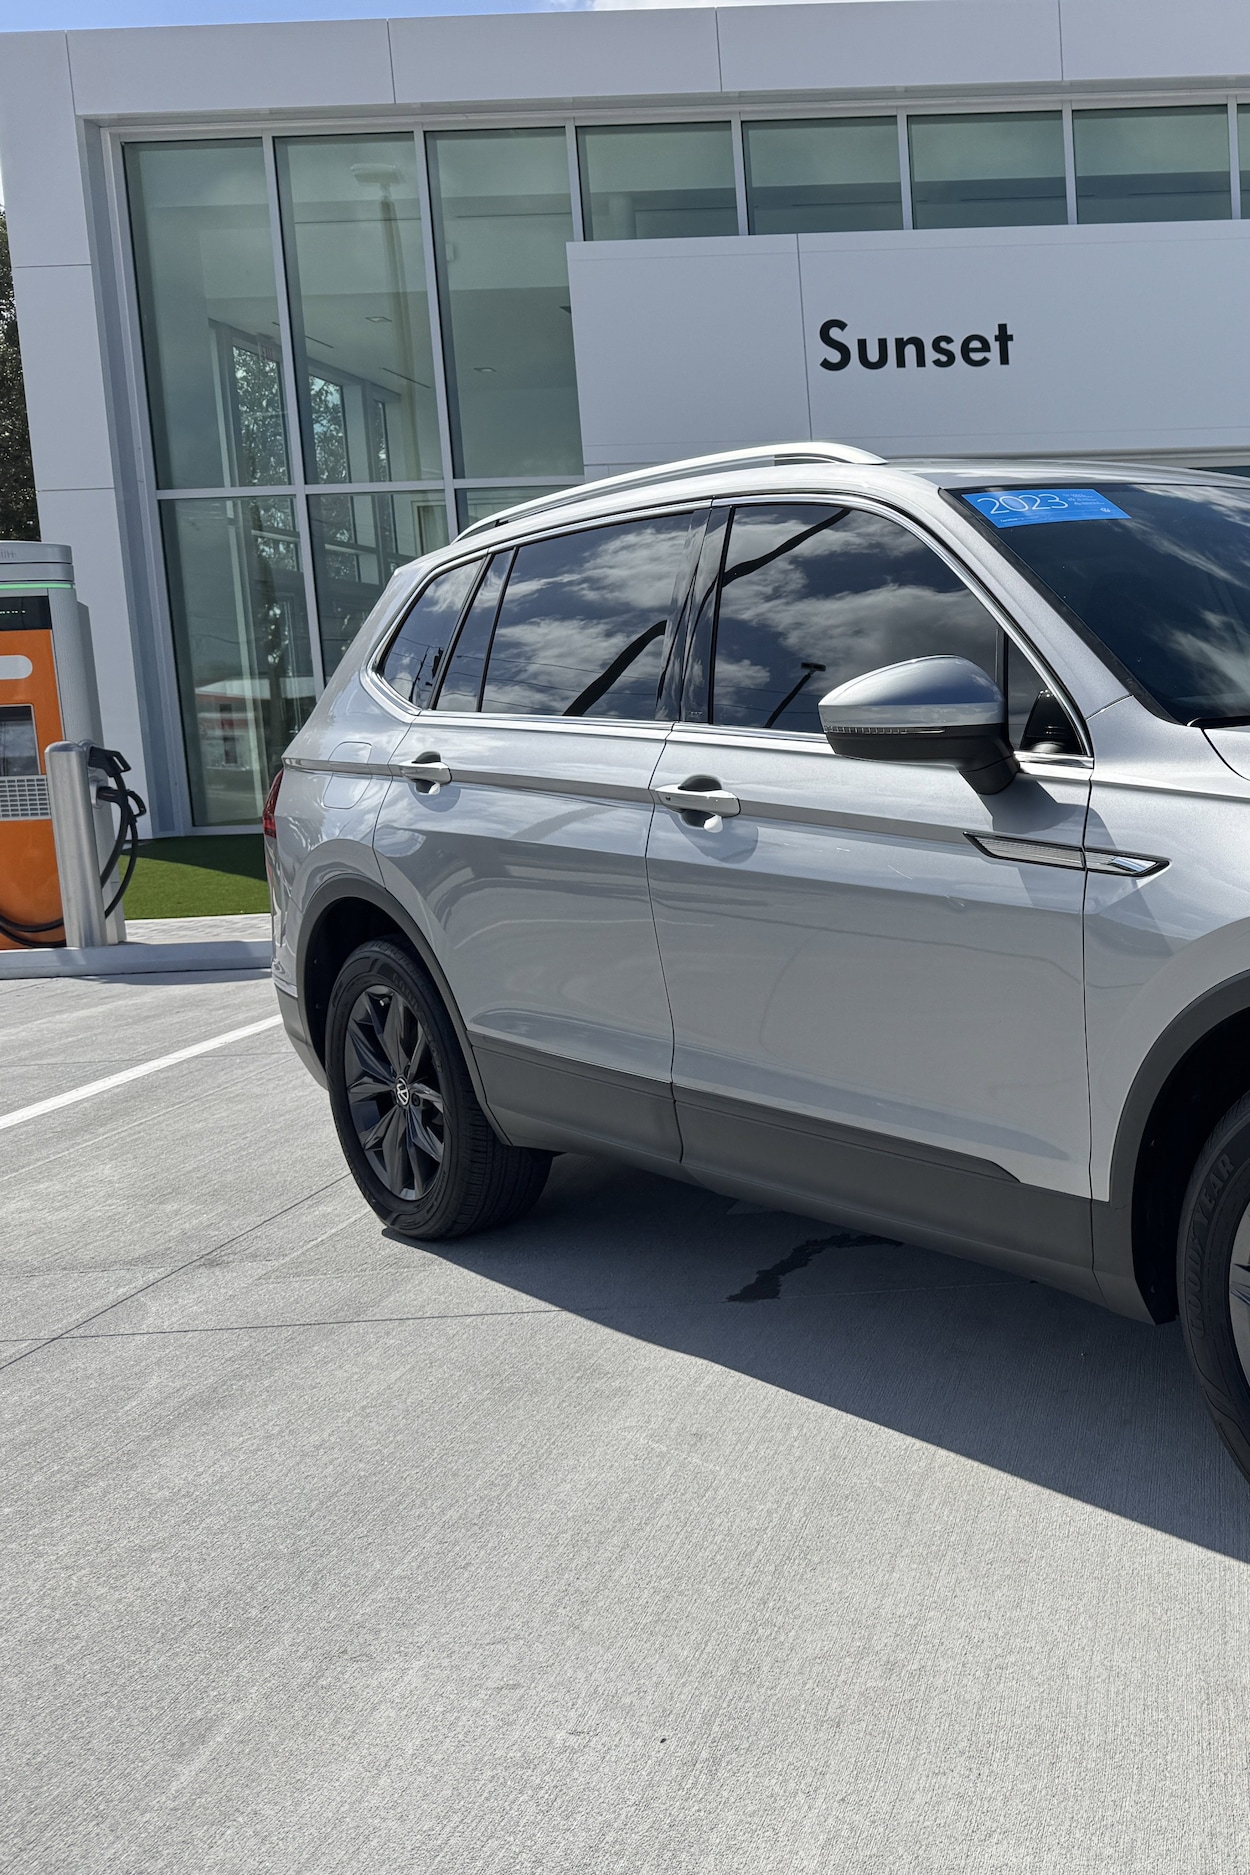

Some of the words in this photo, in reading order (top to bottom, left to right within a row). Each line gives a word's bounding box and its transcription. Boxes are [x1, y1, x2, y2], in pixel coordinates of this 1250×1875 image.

[819, 318, 1014, 371] Sunset
[977, 494, 1069, 514] 2023
[1188, 1151, 1236, 1339] GOODYEAR
